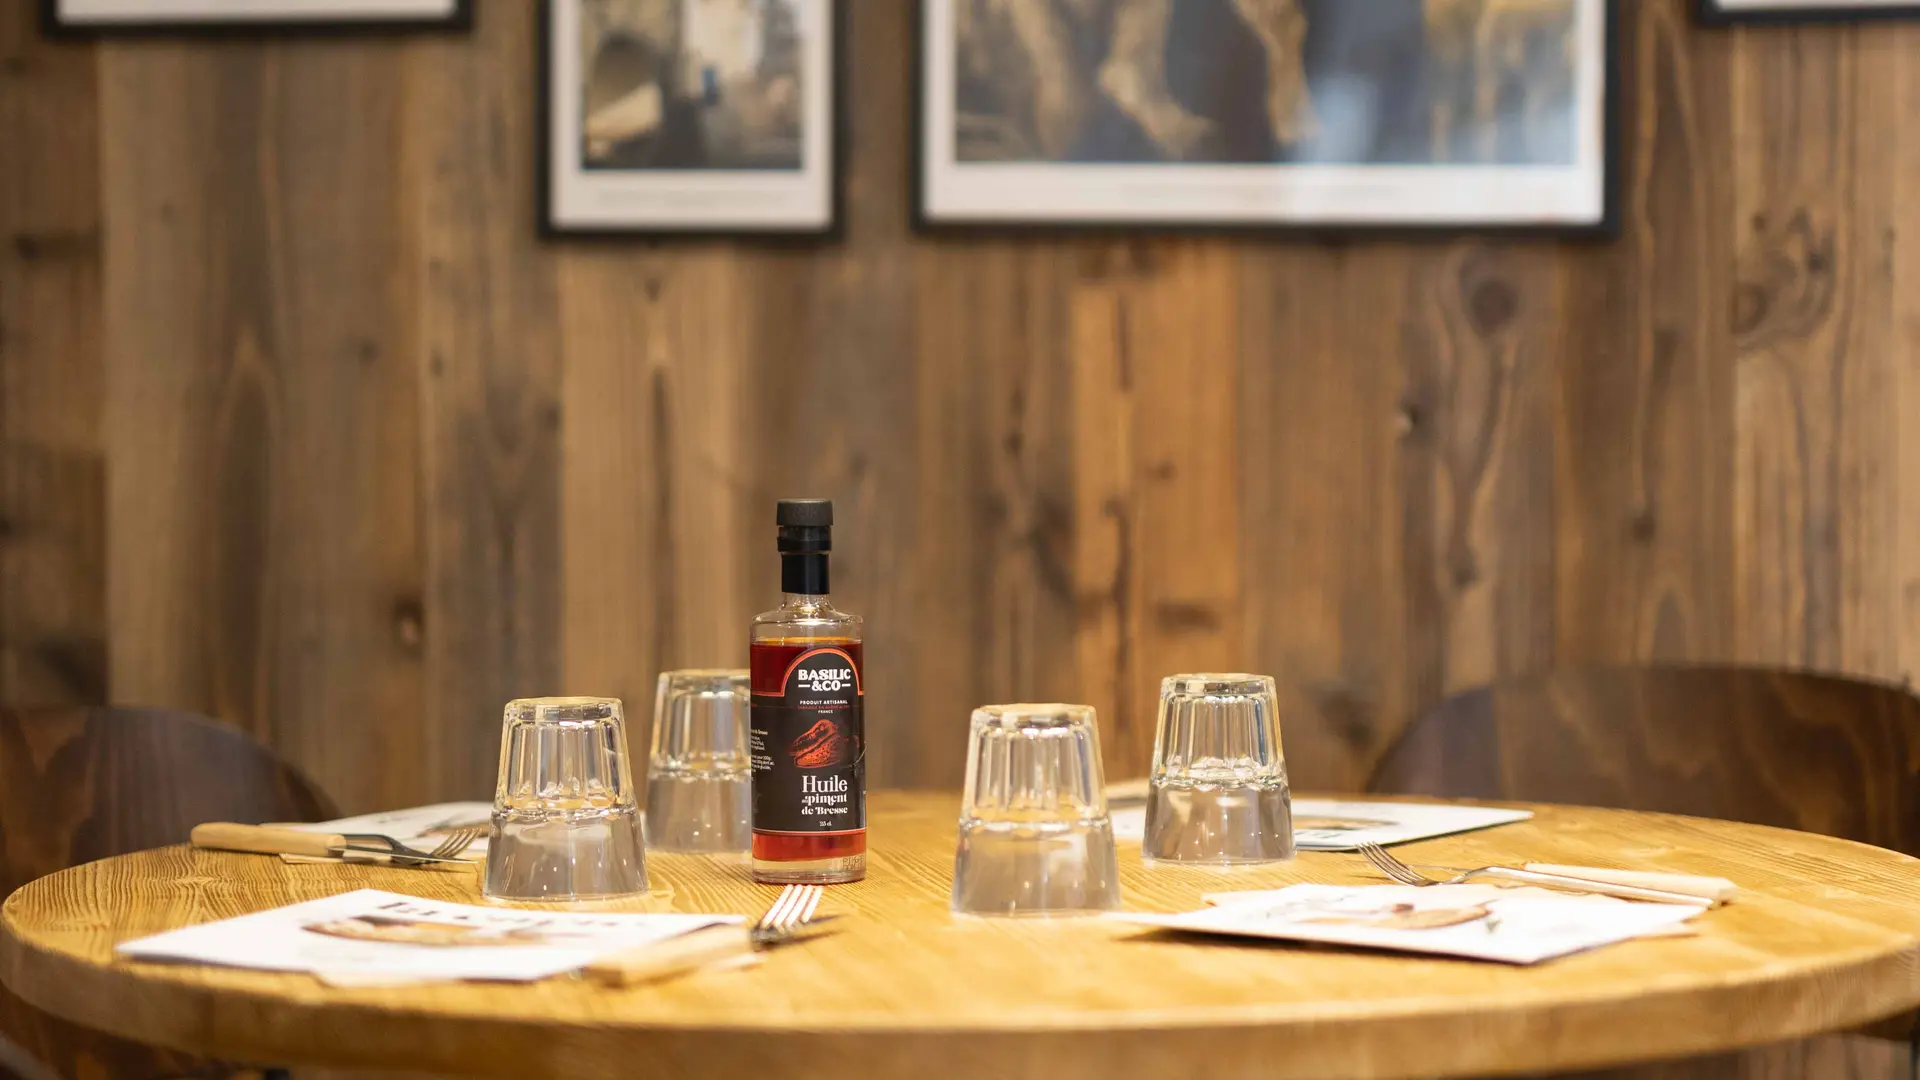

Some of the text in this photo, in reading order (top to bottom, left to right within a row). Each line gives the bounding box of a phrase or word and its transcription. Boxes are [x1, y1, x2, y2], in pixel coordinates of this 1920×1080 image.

[798, 669, 851, 681] BASILIC
[811, 680, 841, 691] &CO
[802, 775, 848, 793] Huile
[804, 793, 847, 806] piment
[801, 806, 848, 815] de Bresse
